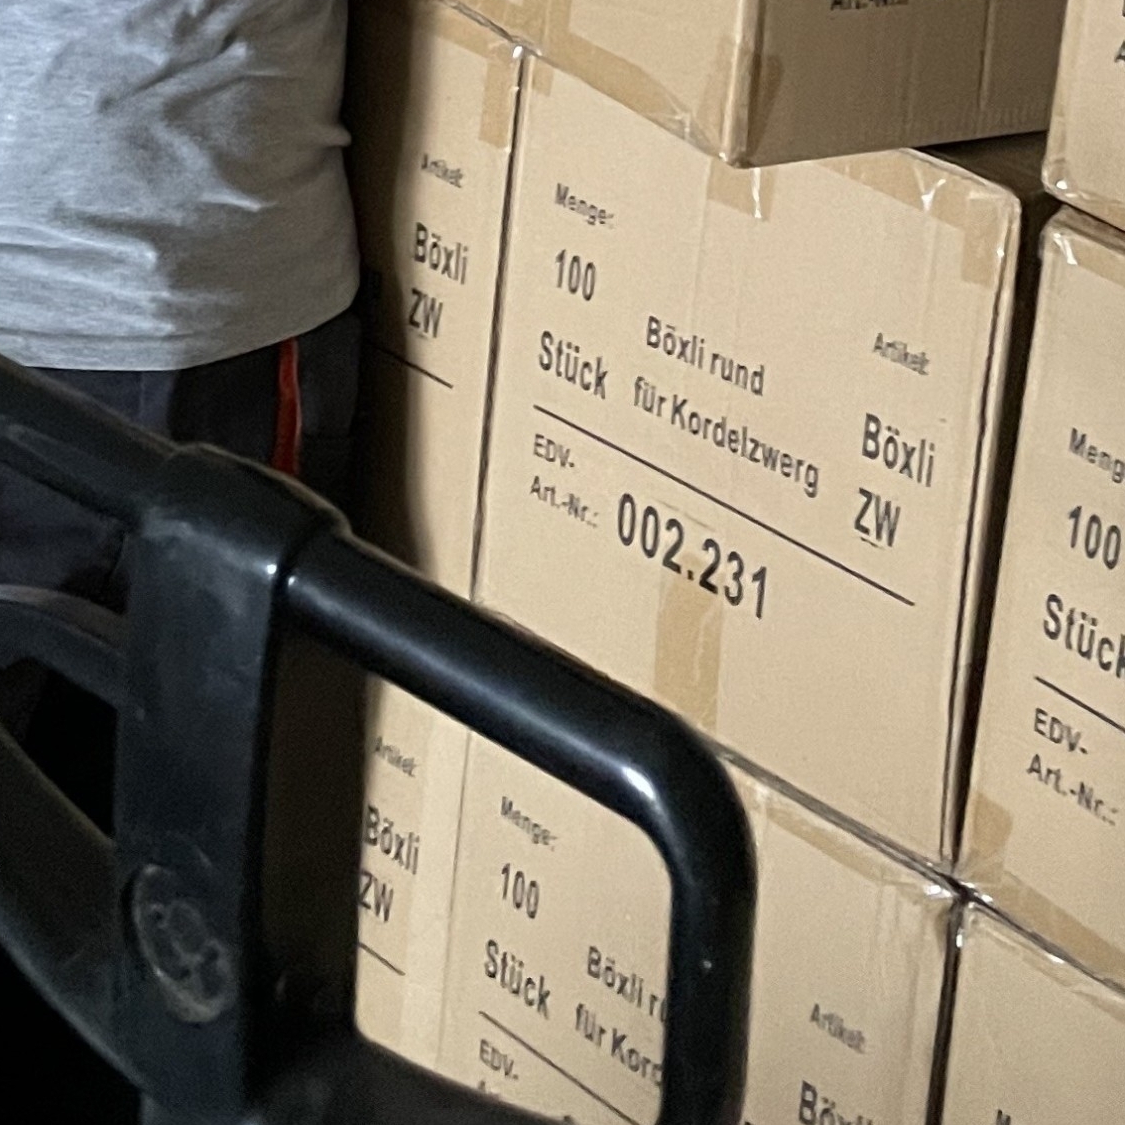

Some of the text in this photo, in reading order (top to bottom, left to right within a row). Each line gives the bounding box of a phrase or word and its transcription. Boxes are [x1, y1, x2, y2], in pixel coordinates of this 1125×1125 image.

[413, 221, 469, 285] Böxli
[555, 248, 597, 303] 100
[408, 287, 443, 339] ZW
[538, 330, 609, 401] Stück
[645, 315, 766, 397] Böxli rund
[632, 375, 820, 498] für Kordelzwerg
[861, 412, 936, 488] Böxli
[853, 486, 901, 548] ZW
[1067, 505, 1122, 571] 100
[617, 492, 768, 620] 002.231
[1033, 707, 1089, 755] EDV-
[363, 803, 421, 876] Böxli
[359, 868, 394, 923] ZW
[500, 862, 540, 920] 100
[484, 938, 552, 1021] Stück
[586, 945, 644, 1009] Böxli
[575, 1002, 607, 1048] für
